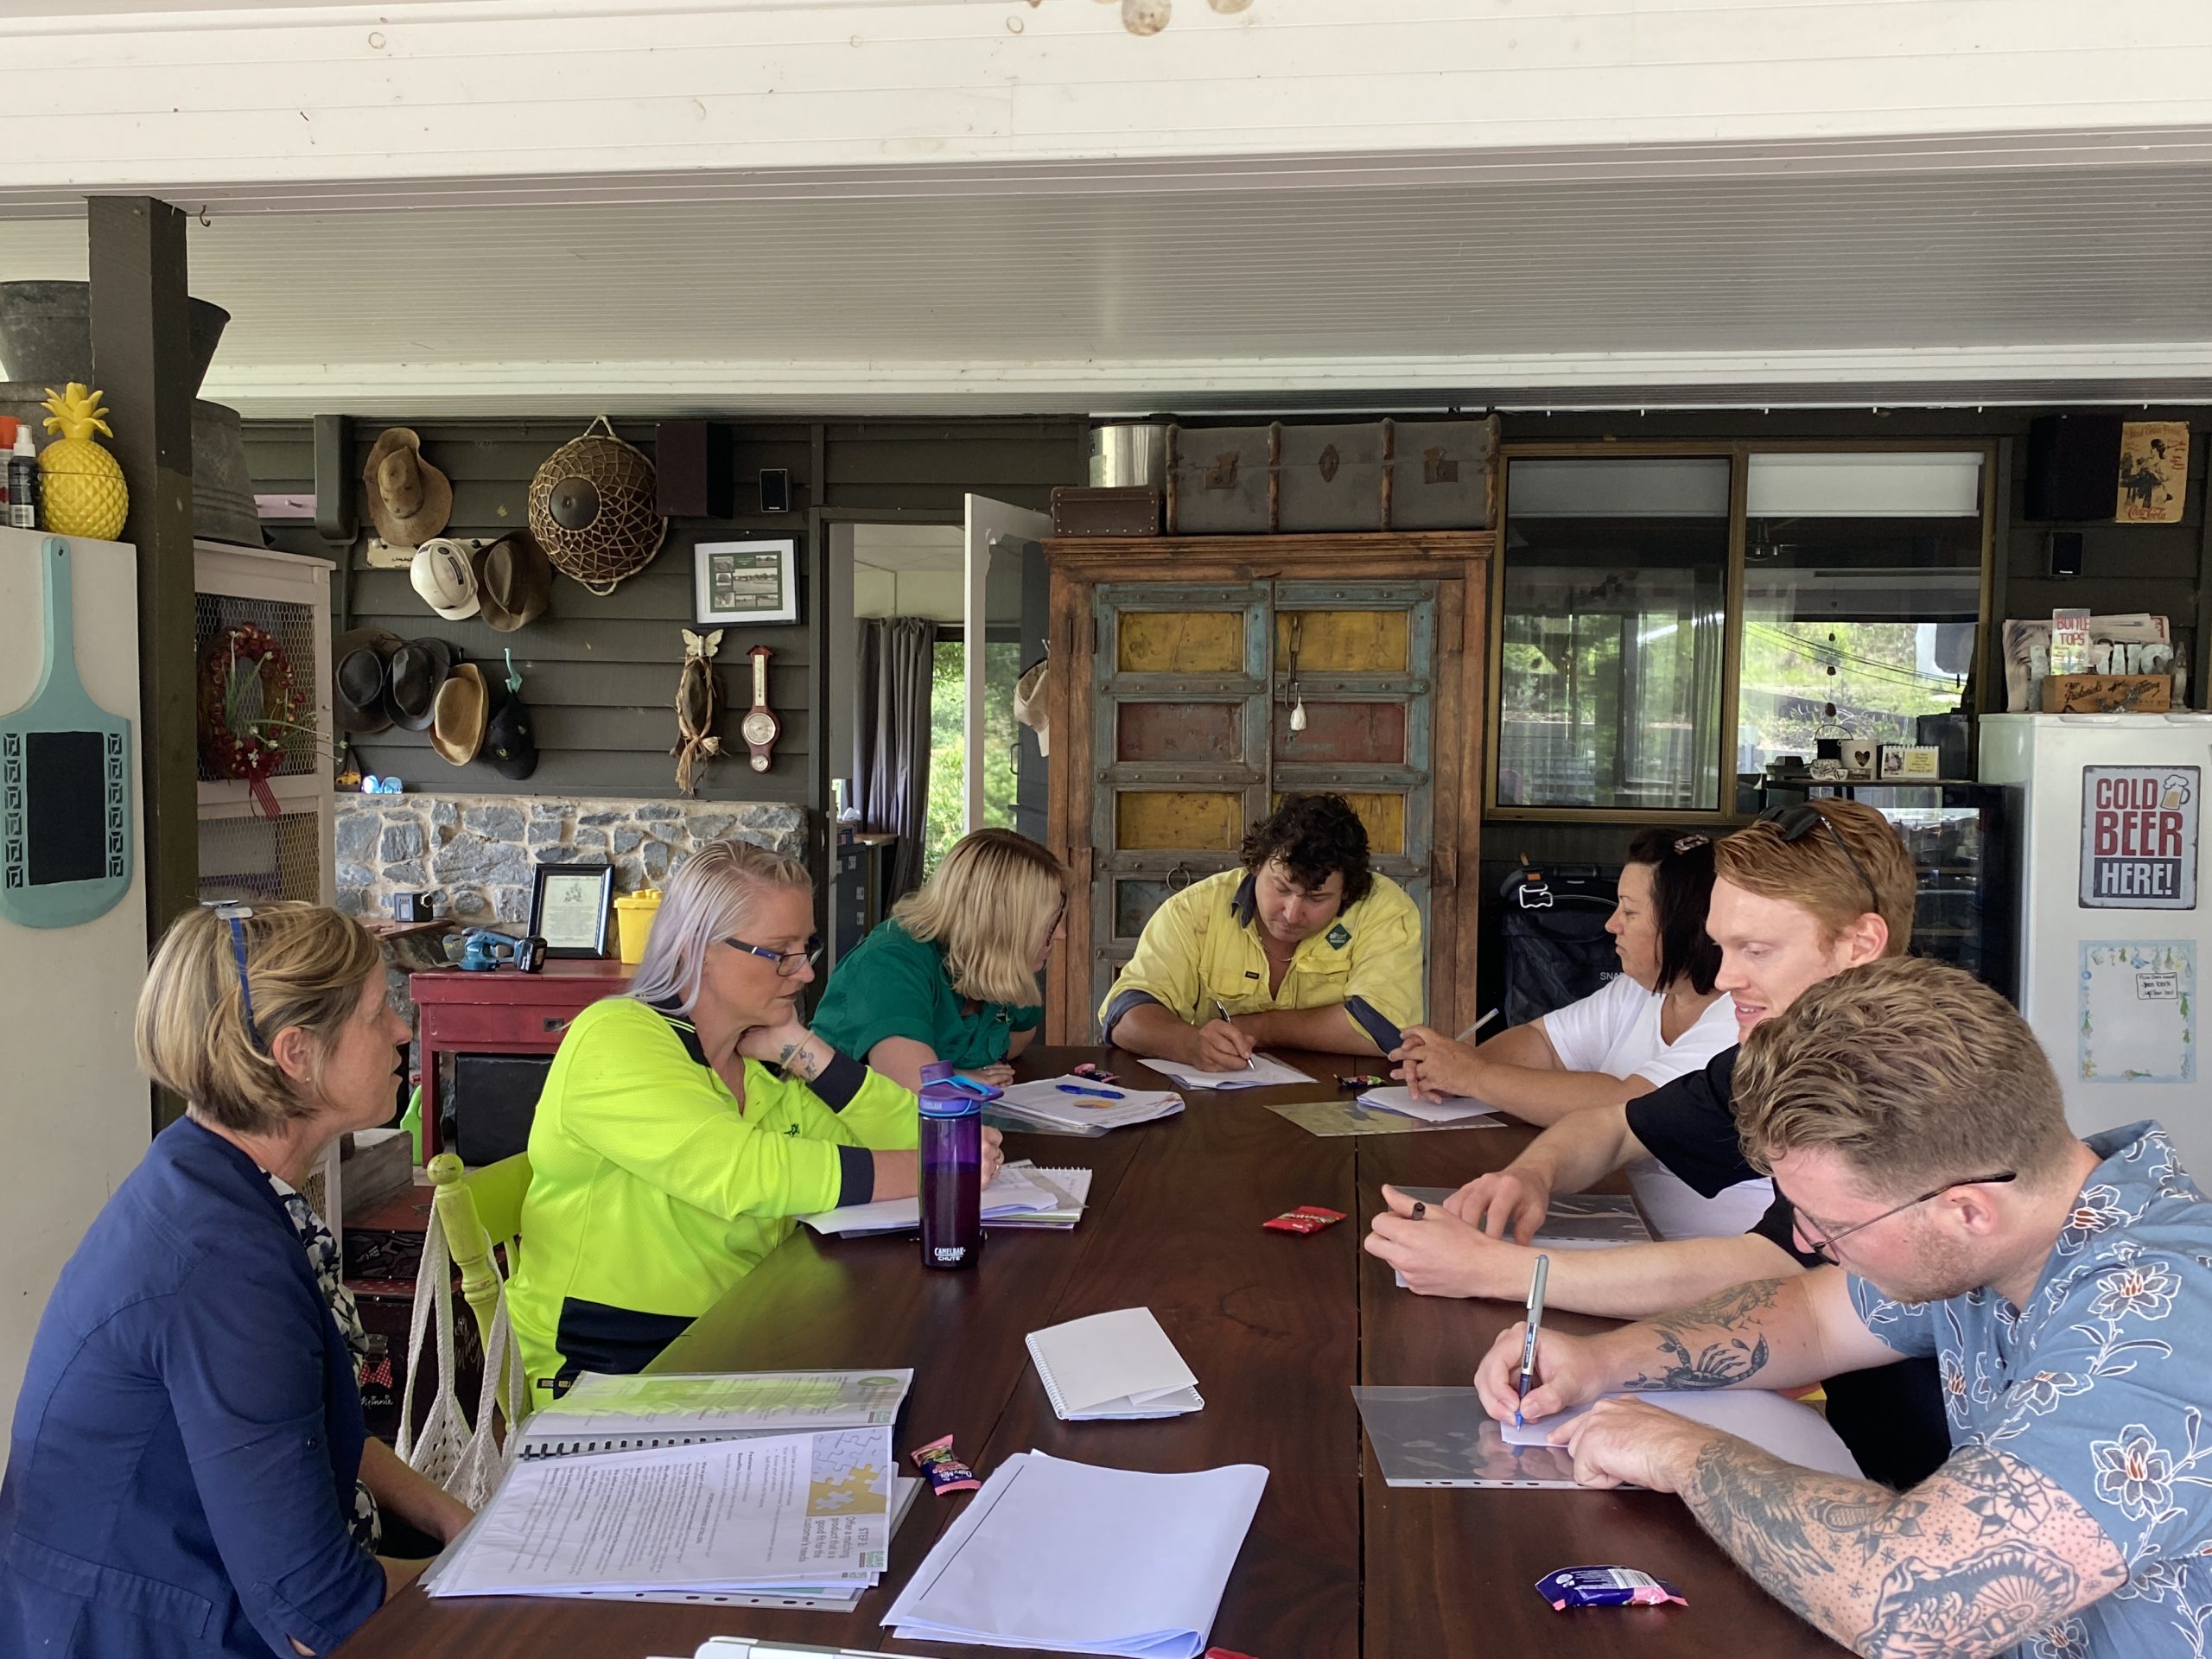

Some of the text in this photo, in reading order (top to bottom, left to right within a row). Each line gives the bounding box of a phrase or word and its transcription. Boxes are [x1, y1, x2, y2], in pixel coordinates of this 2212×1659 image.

[2128, 505, 2166, 519] Coca-Cola
[2057, 614, 2089, 630] BOTTLE
[2059, 632, 2084, 645] TOPS
[2096, 779, 2158, 810] COLD
[2094, 811, 2183, 856] BEER
[2101, 862, 2173, 895] HERE!
[816, 1520, 827, 1534] good
[830, 1518, 841, 1539] product
[845, 1516, 855, 1531] Offer
[858, 1528, 868, 1542] STEP
[830, 1539, 838, 1551] that
[839, 1535, 851, 1558] matching
[798, 1547, 809, 1562] needs
